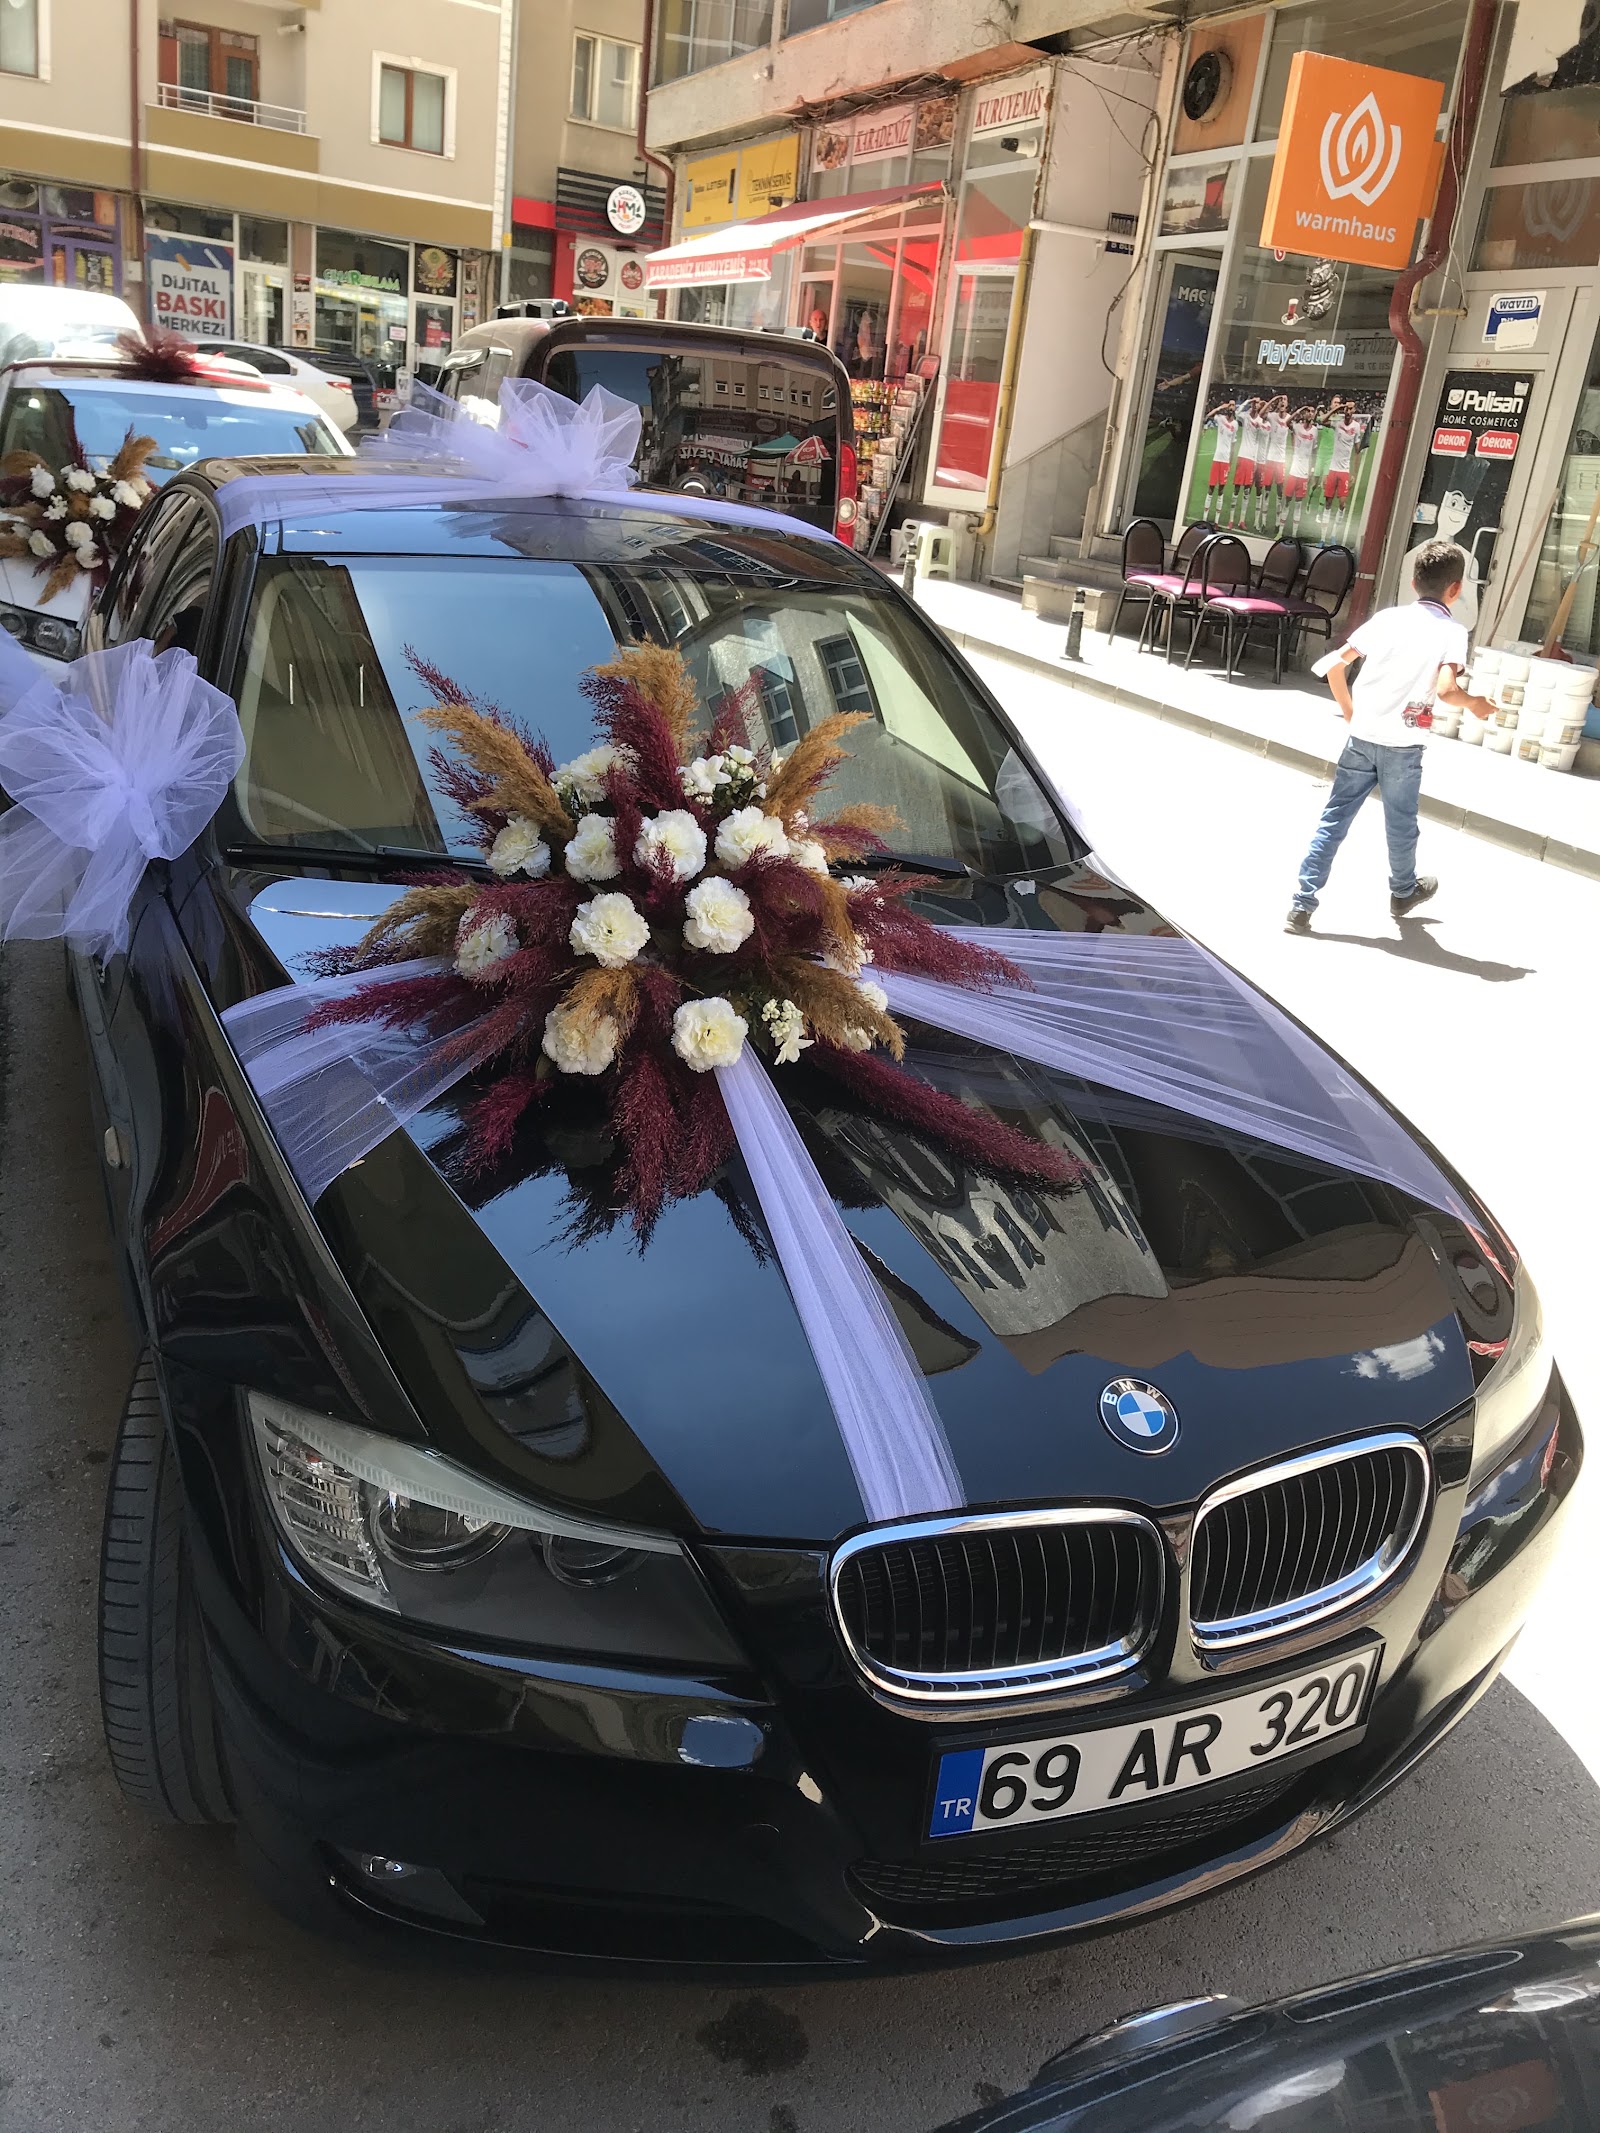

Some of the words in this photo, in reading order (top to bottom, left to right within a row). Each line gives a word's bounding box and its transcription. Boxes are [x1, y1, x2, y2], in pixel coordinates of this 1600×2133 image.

[975, 81, 1045, 128] KURUYEMİŞ
[1295, 210, 1397, 243] warmhaus
[161, 273, 220, 295] DİJİTAL
[1178, 285, 1207, 307] MAÇ
[156, 291, 226, 320] BASKI
[158, 315, 226, 337] MERKEZİ
[1257, 339, 1346, 372] PlayStation
[1463, 389, 1524, 414] Polisan
[1442, 414, 1466, 425] HOME
[1470, 416, 1519, 428] COSMETICS
[1103, 1380, 1161, 1406] BMW
[979, 1743, 1082, 1820] 69
[1108, 1713, 1222, 1800] AR
[1249, 1663, 1368, 1757] 320
[940, 1797, 971, 1819] TR
